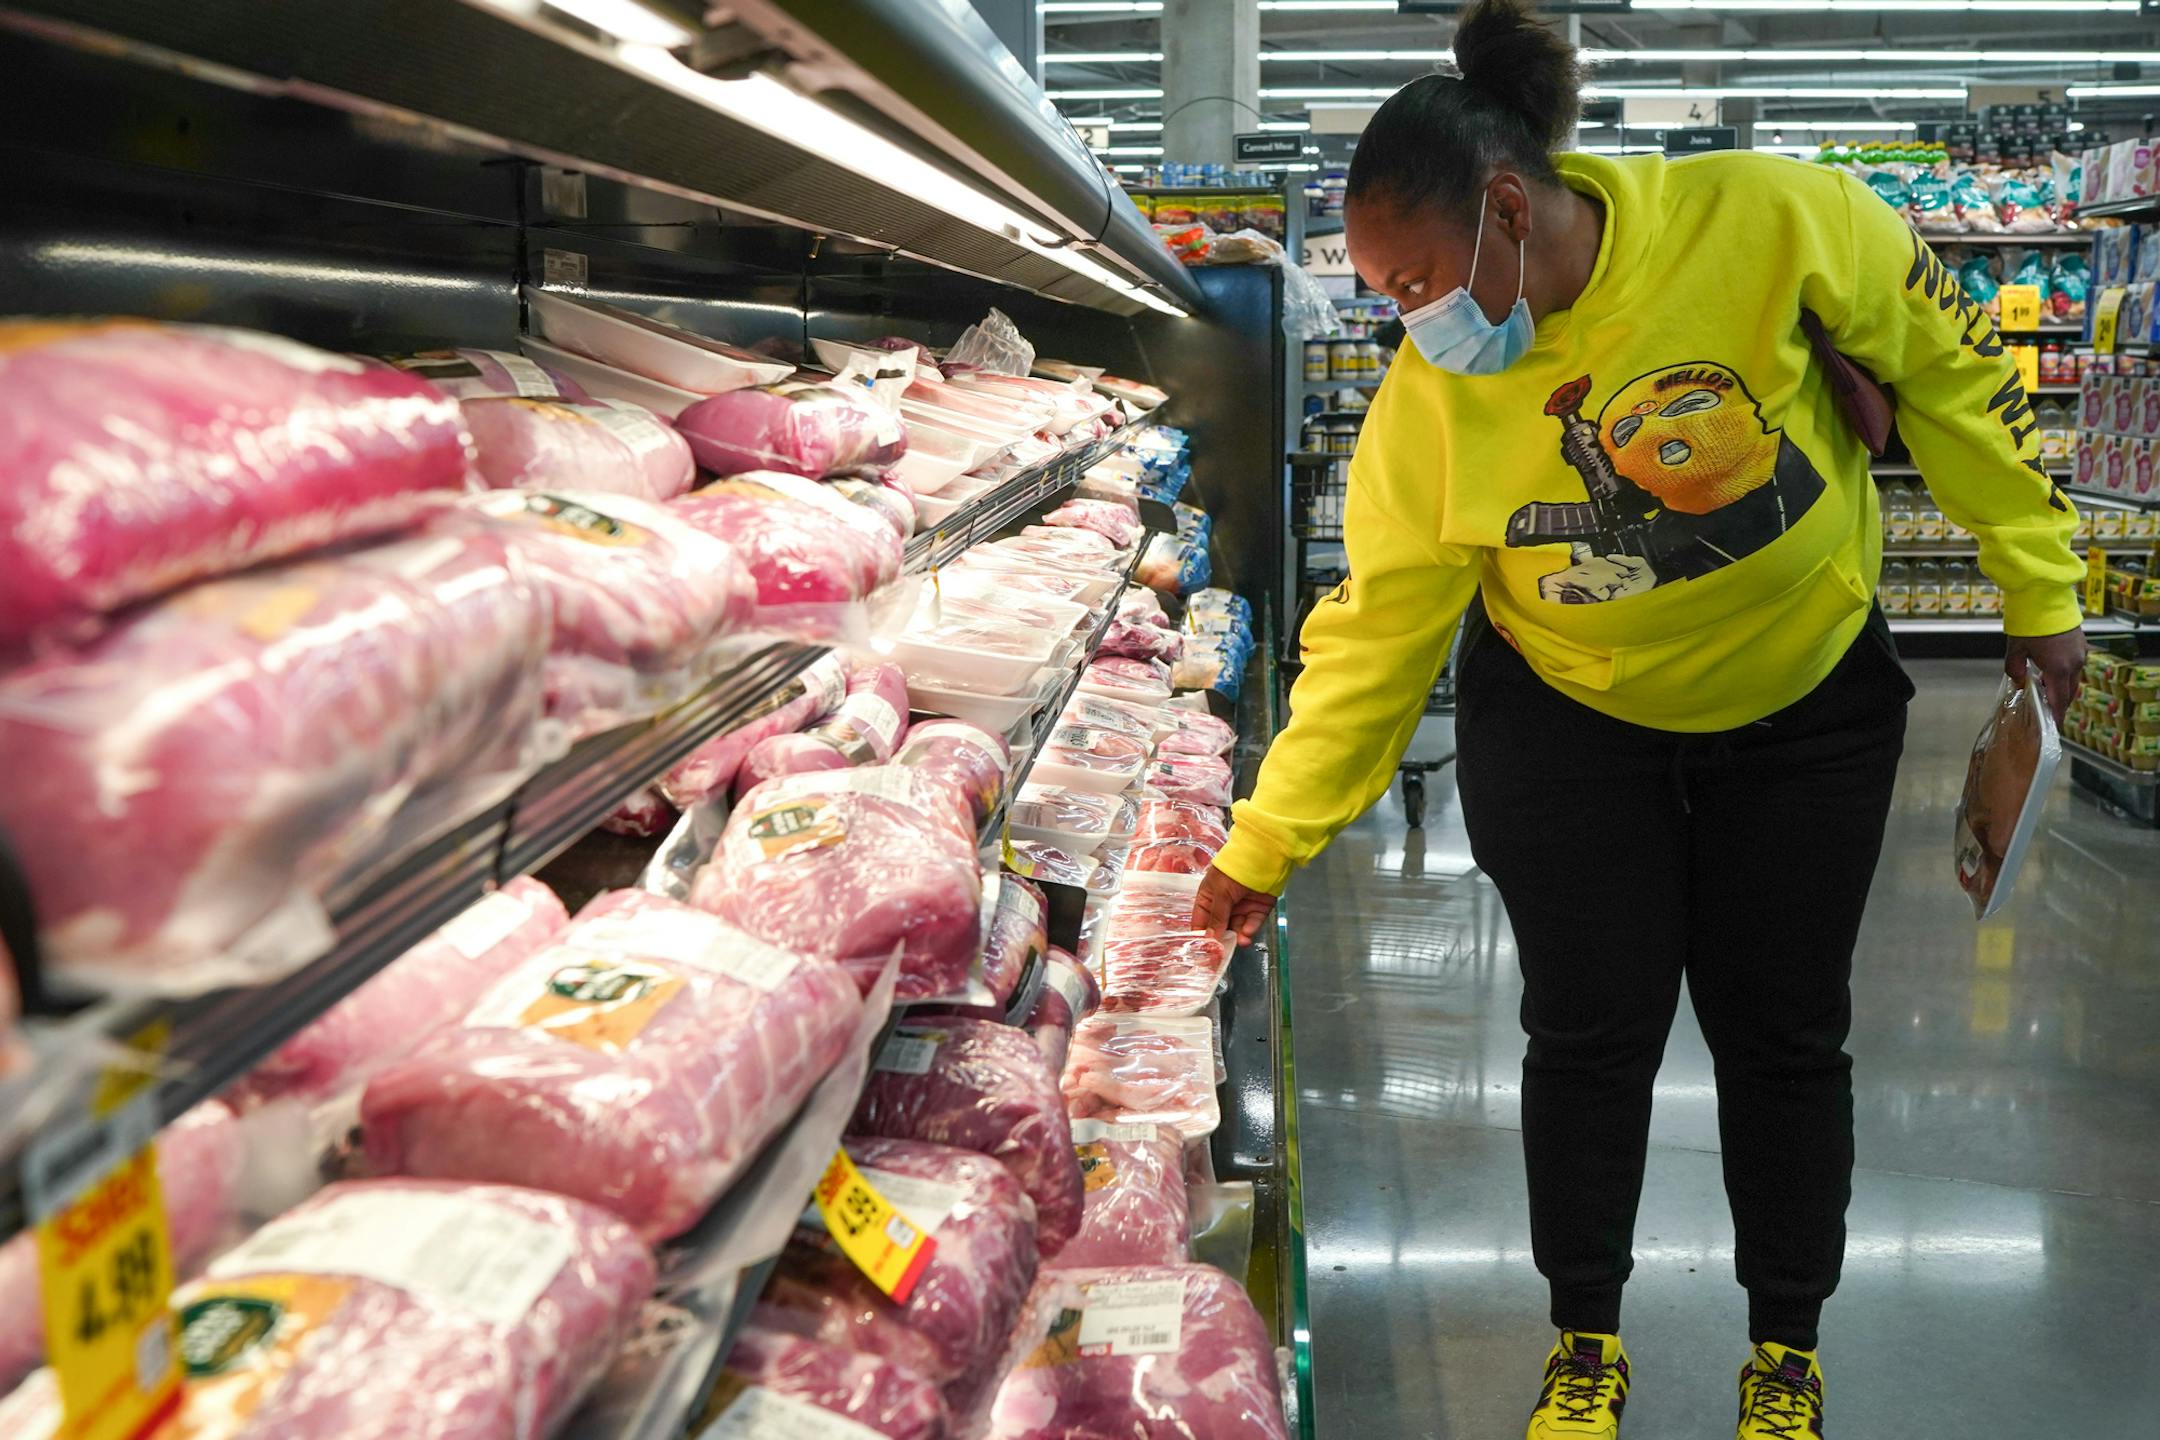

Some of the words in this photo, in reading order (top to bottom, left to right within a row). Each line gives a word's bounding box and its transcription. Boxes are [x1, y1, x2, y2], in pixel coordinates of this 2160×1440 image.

[1688, 103, 1702, 120] 4
[1083, 128, 1093, 146] 2
[1689, 135, 1712, 145] Juice
[1242, 143, 1273, 152] Canned
[1274, 142, 1295, 151] Meat
[1905, 226, 2004, 357] WORLD
[1654, 368, 1733, 392] HELLO?
